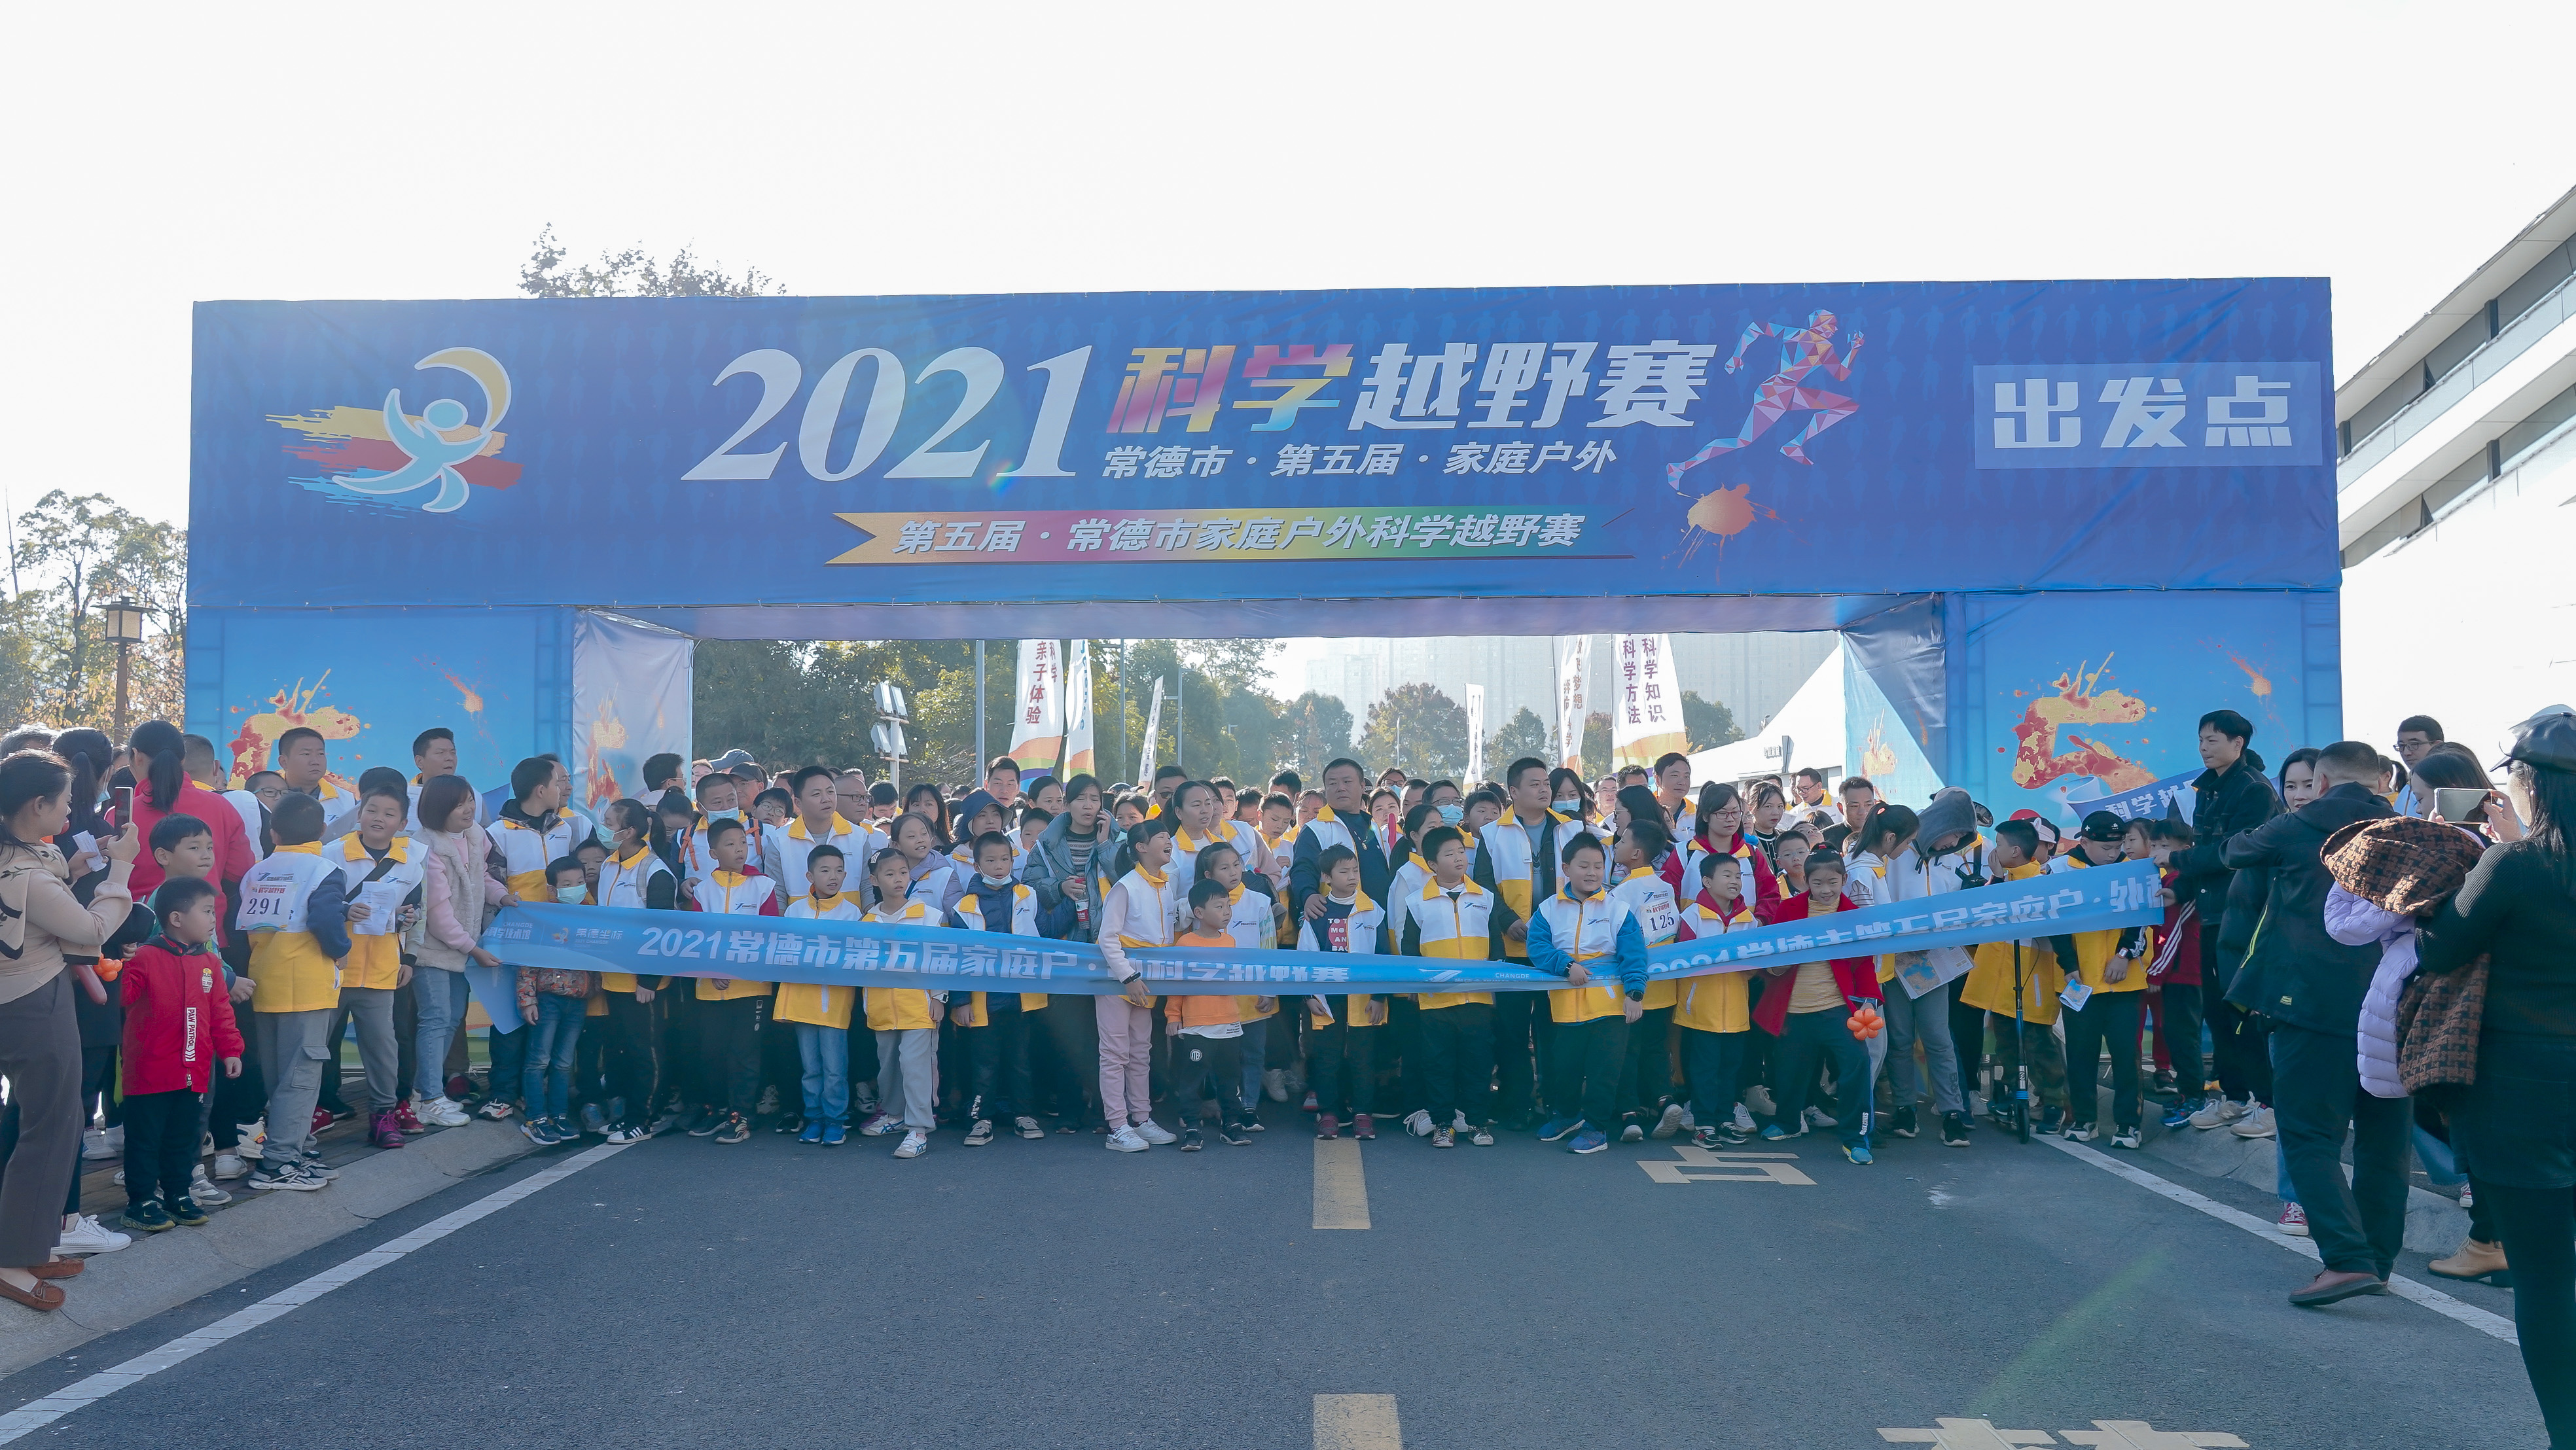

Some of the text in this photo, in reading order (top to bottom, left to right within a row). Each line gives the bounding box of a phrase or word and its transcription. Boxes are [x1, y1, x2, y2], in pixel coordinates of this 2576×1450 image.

[681, 340, 1717, 482] 2021 科学越野赛
[1994, 375, 2293, 449] 出发点
[1025, 641, 1047, 724] 亲子体验
[1622, 639, 1641, 724] 科学方法
[1641, 636, 1666, 722] 科学知识
[246, 898, 281, 915] 291
[1649, 911, 1675, 932] 125
[187, 1008, 196, 1048] PAW PATROL
